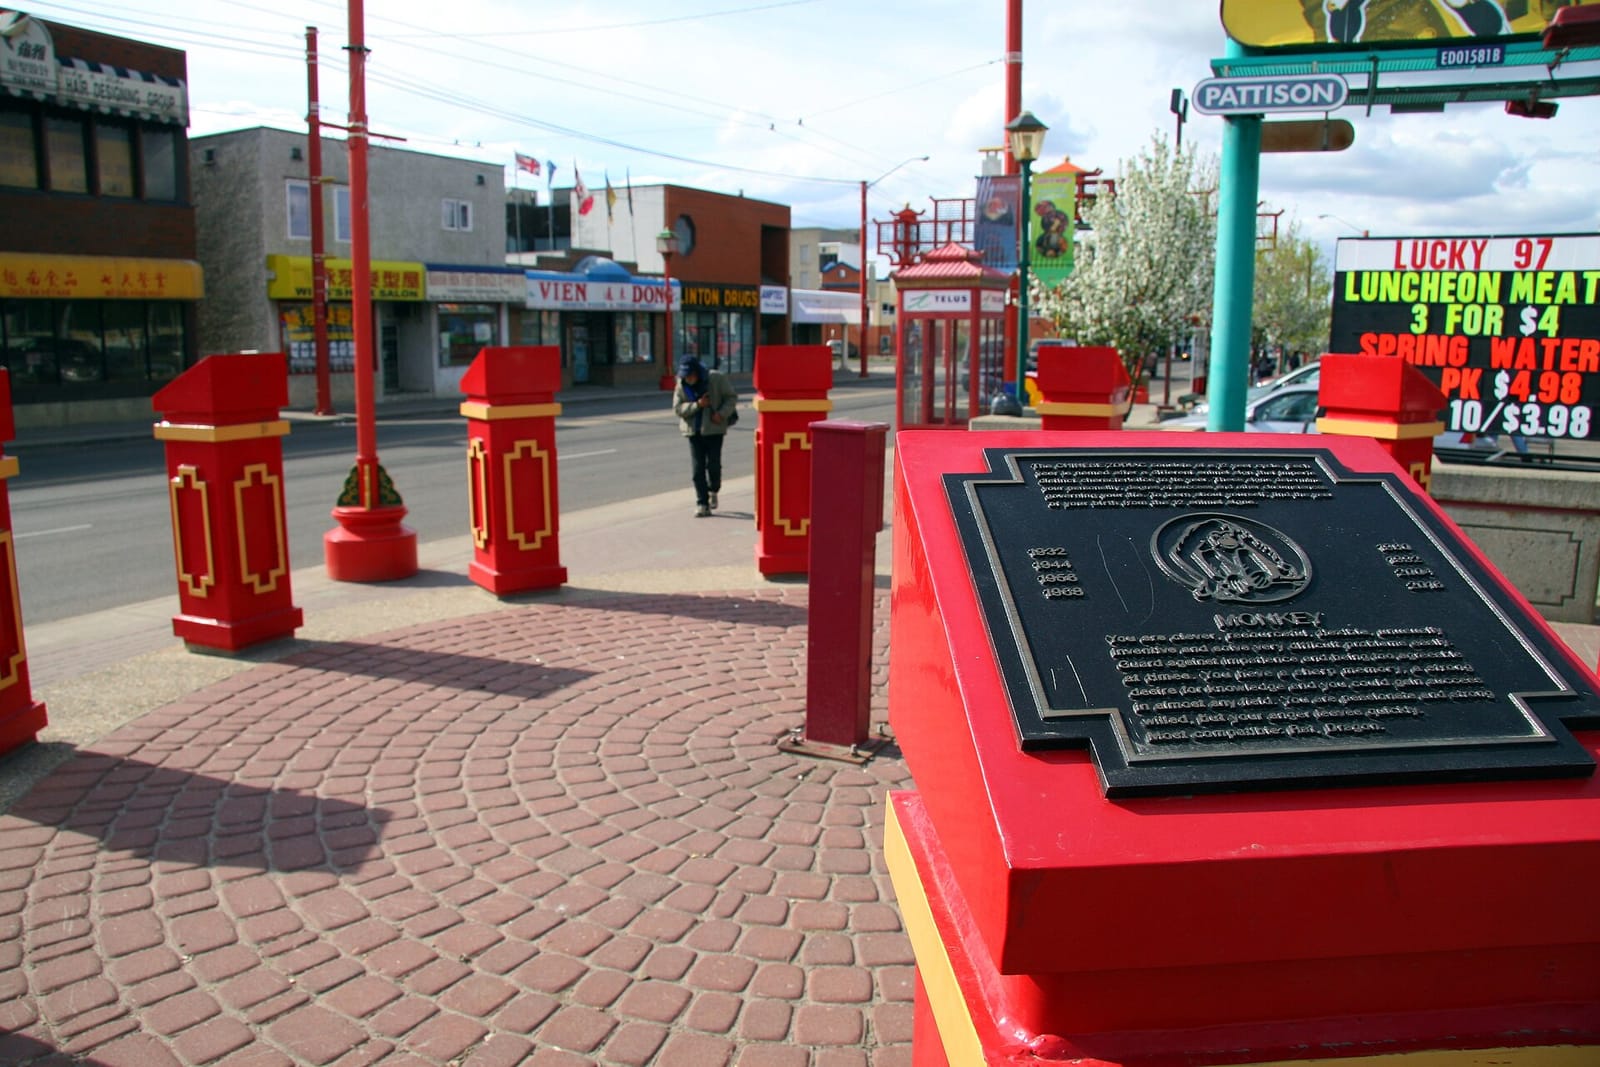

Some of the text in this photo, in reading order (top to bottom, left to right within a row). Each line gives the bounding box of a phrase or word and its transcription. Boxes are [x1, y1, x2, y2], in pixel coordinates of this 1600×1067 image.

[1204, 80, 1336, 107] PATTISON
[1393, 238, 1554, 271] LUCKY 97
[538, 281, 588, 303] VIEN
[1344, 270, 1600, 305] LUNCHEON MEAT
[724, 288, 759, 307] DRUGS
[934, 295, 968, 303] TELUS
[1409, 303, 1560, 338] 3 FOR $4
[1358, 332, 1600, 373] SPRING WATER
[1440, 367, 1583, 405] PK $4.98
[1449, 399, 1593, 439] 10/$3.98
[1031, 560, 1073, 572] 1944
[1213, 610, 1321, 632] MONKEY
[1105, 634, 1136, 647] You
[1179, 644, 1209, 655] and
[1116, 659, 1163, 673] Guard
[1166, 657, 1219, 669] against
[1300, 653, 1327, 664] and
[1199, 669, 1232, 681] You
[1128, 687, 1177, 700] desire
[1205, 682, 1285, 697] knowledge
[1288, 681, 1317, 692] and
[1318, 681, 1347, 693] you
[1153, 700, 1206, 712] almost
[1279, 695, 1310, 707] You
[1227, 711, 1263, 726] your
[1145, 729, 1189, 743] Most
